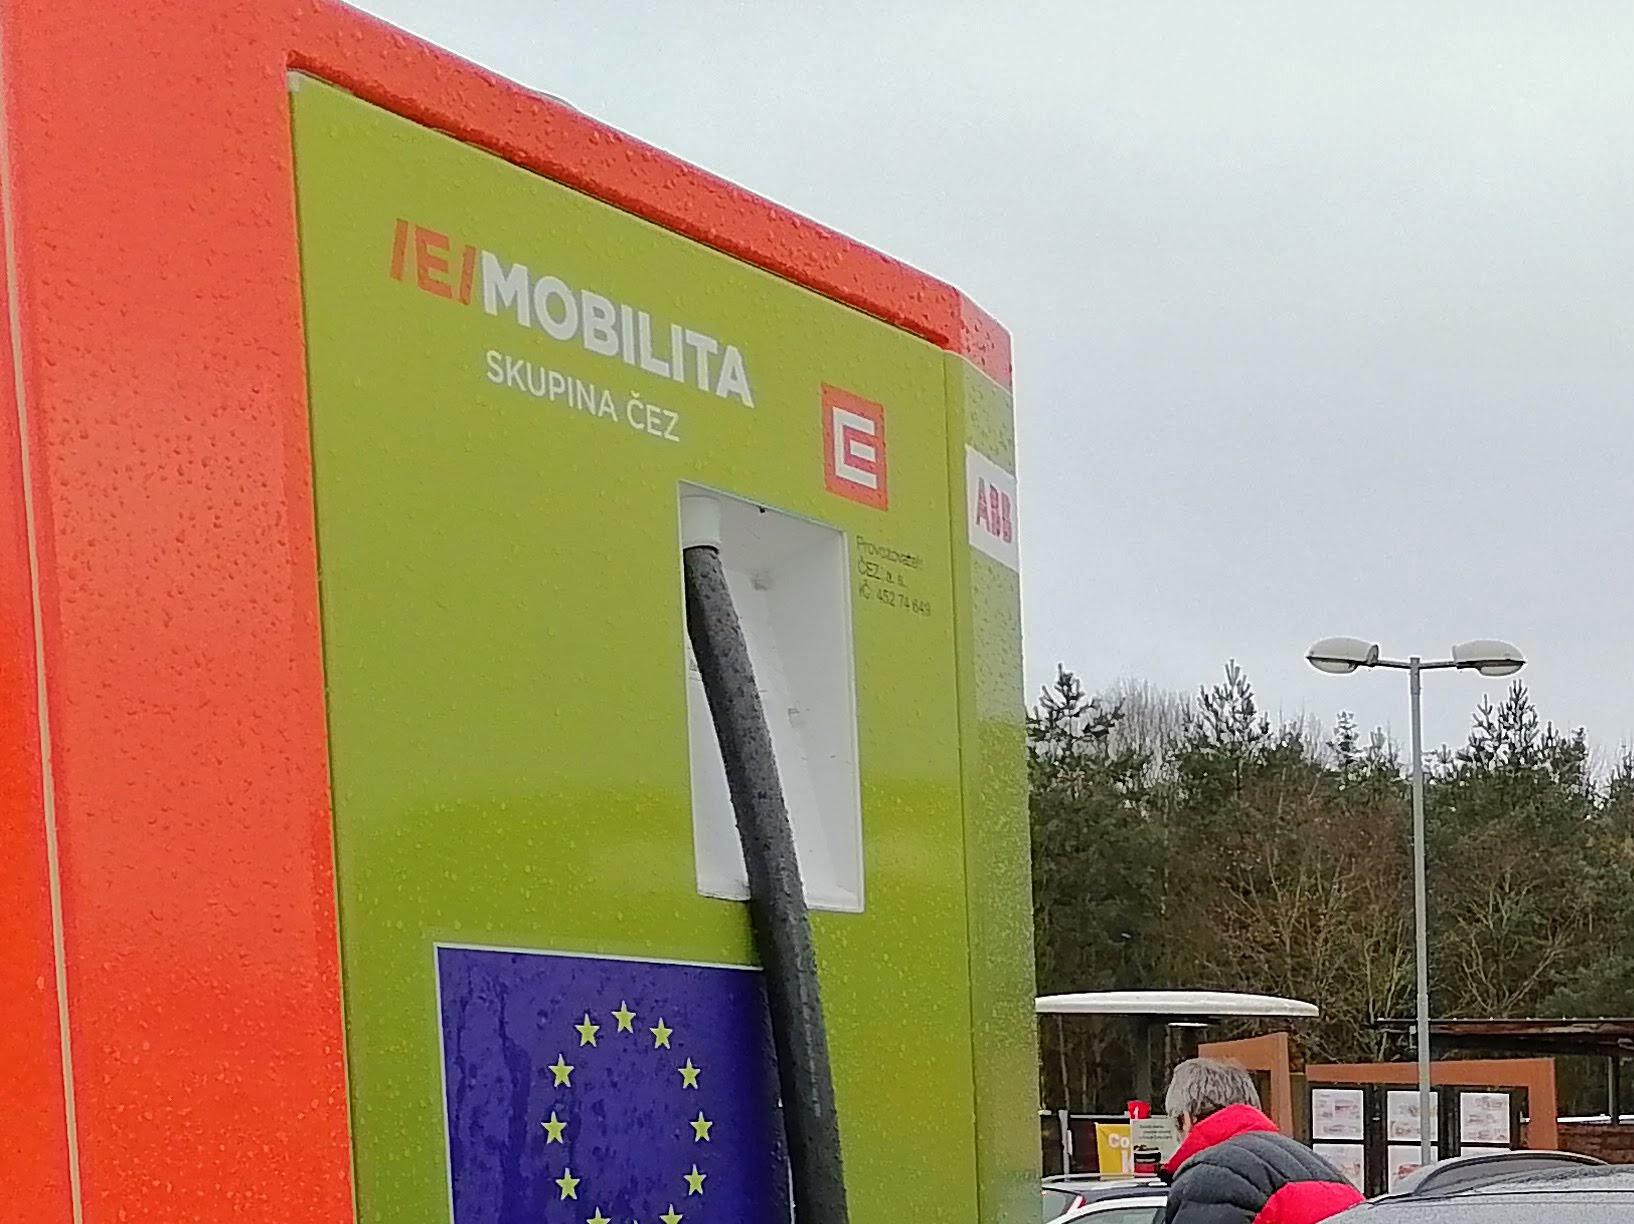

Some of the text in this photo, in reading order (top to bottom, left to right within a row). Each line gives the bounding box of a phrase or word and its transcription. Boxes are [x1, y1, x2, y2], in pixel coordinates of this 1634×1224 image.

[485, 349, 681, 442] SKUPINA ČEZ
[976, 476, 1013, 544] ABB
